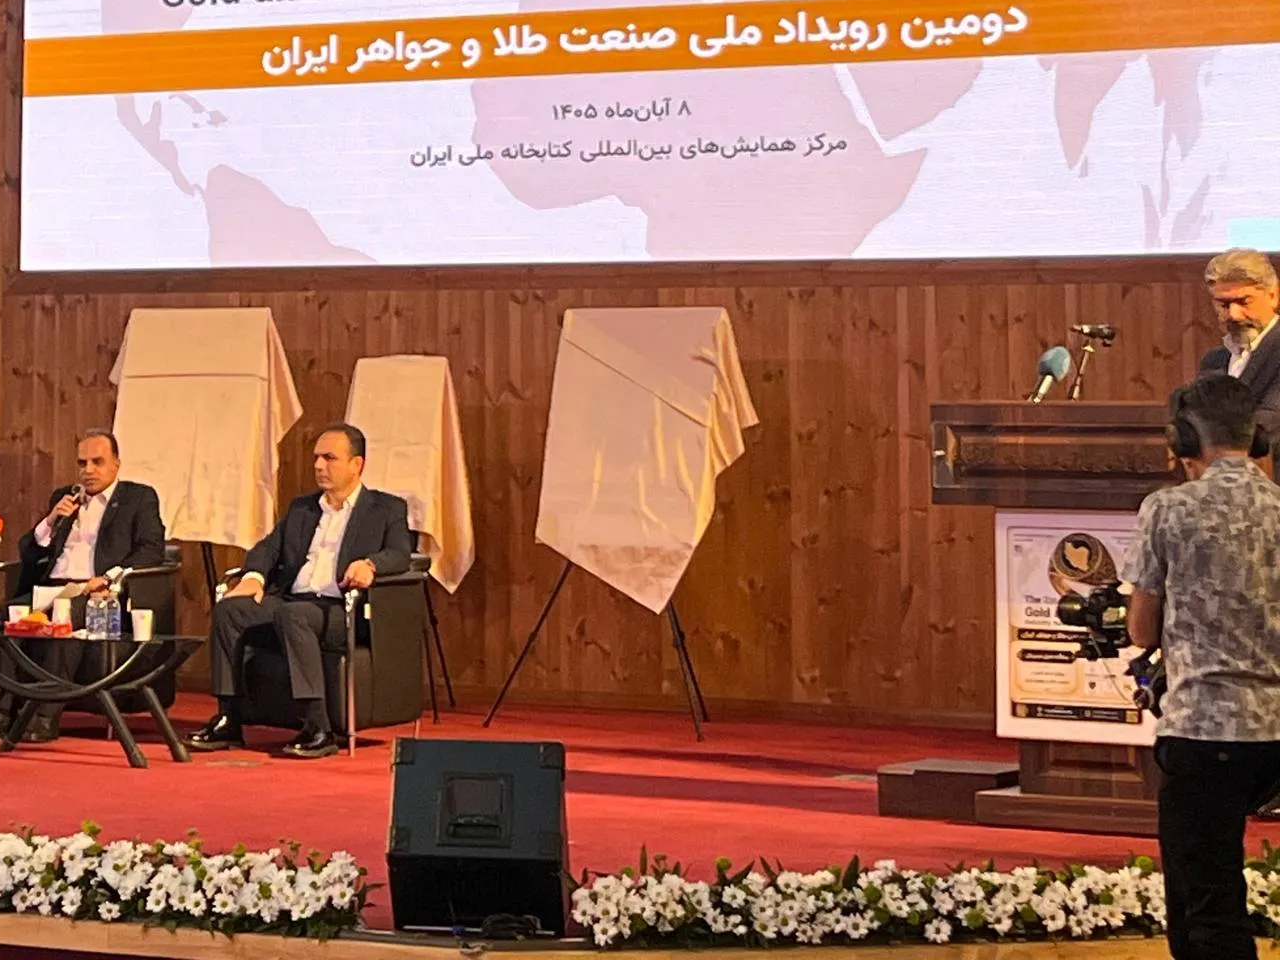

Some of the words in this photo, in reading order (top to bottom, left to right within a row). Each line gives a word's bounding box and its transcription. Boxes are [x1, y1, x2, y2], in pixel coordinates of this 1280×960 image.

[493, 24, 548, 57] طلا
[559, 22, 677, 54] صنعت
[689, 13, 762, 58] ملی
[773, 10, 885, 52] رویداد
[900, 5, 1028, 49] دومین
[261, 34, 338, 76] ایران
[347, 30, 452, 73] جواهر
[462, 38, 481, 66] و
[552, 104, 598, 121] ۱۴۰۵
[678, 100, 692, 116] ۸
[410, 145, 452, 168] ایران
[458, 143, 494, 166] ملی
[500, 140, 572, 164] کتابخانه
[803, 132, 848, 157] مرکز
[1025, 607, 1051, 618] Gold
